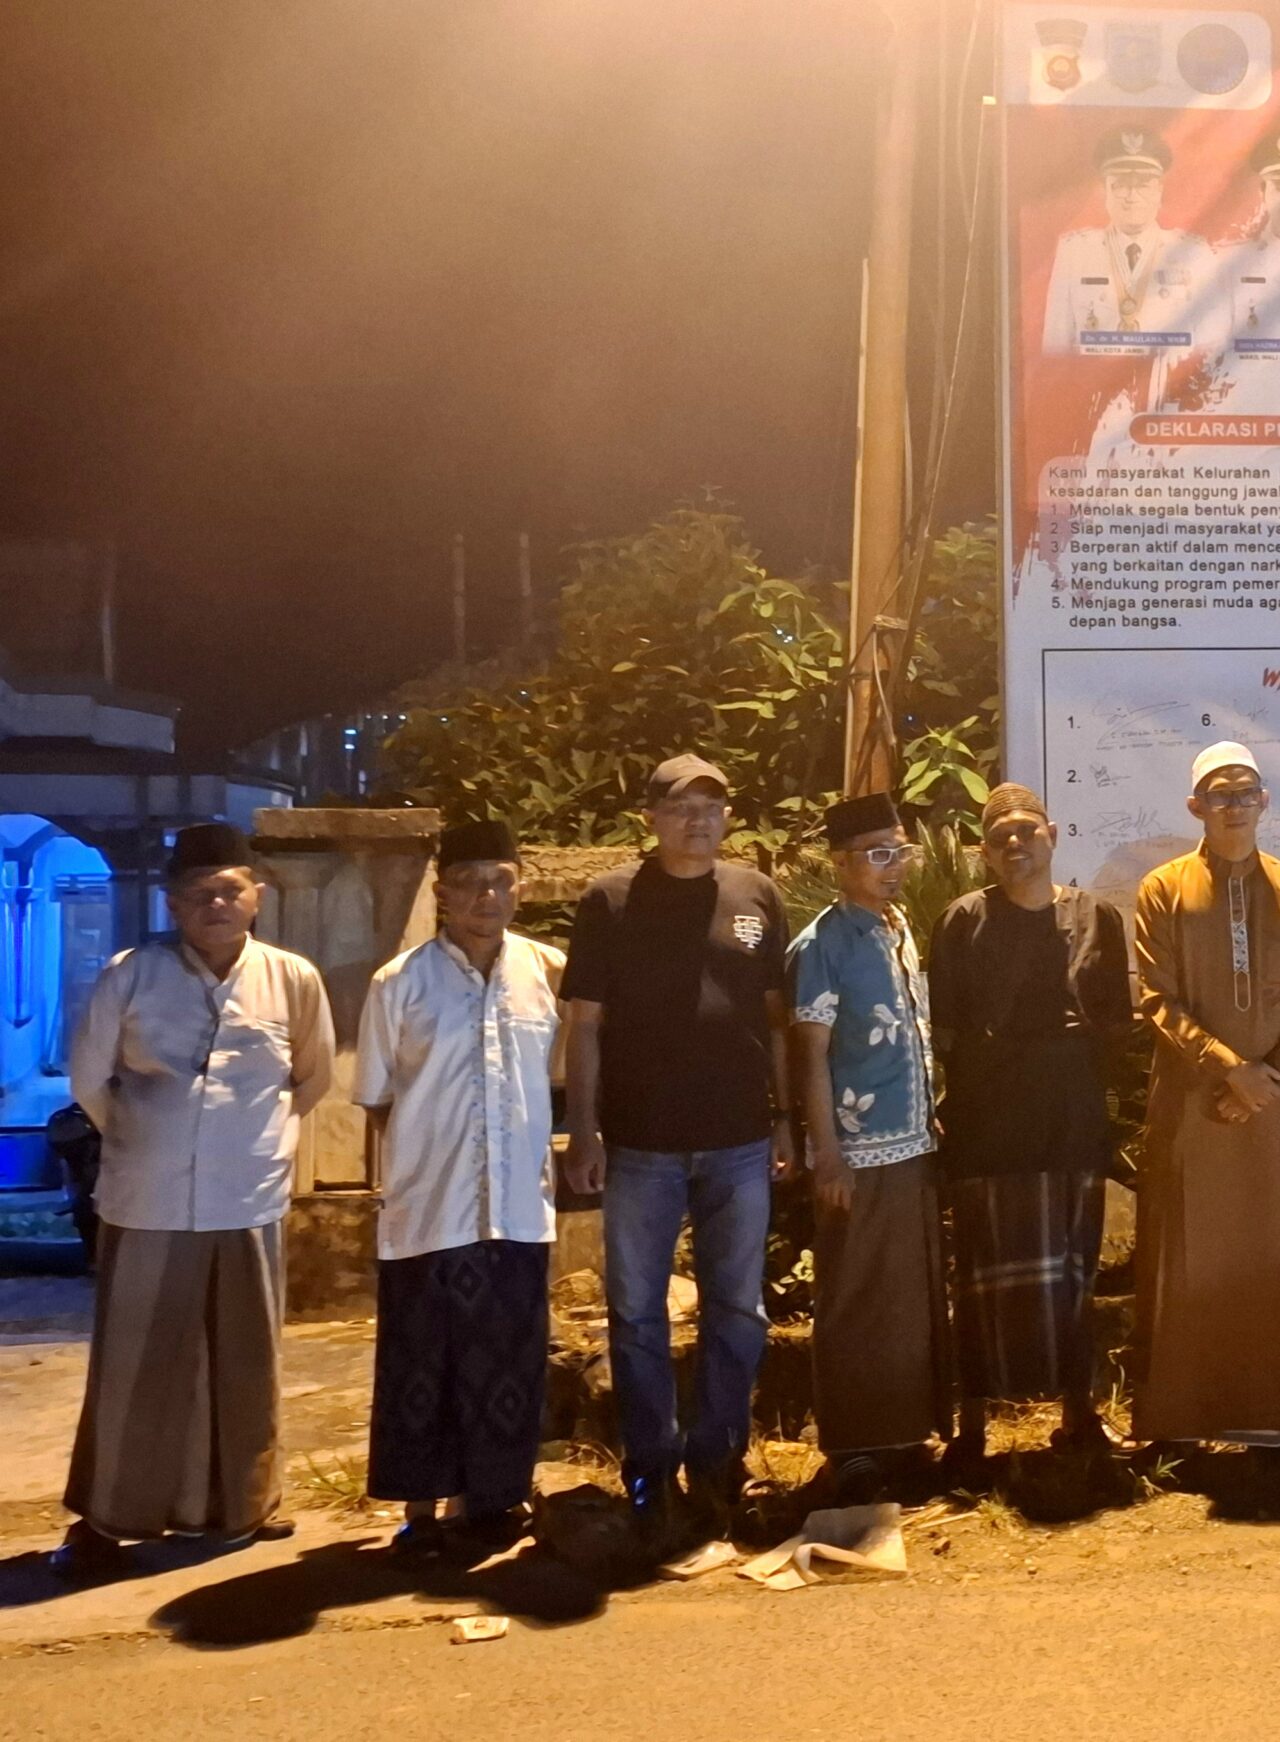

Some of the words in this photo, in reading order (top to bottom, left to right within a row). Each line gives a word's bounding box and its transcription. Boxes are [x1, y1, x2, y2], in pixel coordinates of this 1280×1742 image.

[1146, 422, 1257, 437] DEKLARASI
[1049, 466, 1087, 478] Kami
[1096, 466, 1184, 482] masyarakat
[1194, 467, 1270, 479] Kelurahan
[1049, 485, 1129, 497] kesadaran
[1135, 485, 1162, 497] dan
[1168, 485, 1238, 501] tanggung
[1070, 504, 1133, 516] Menolak
[1139, 504, 1189, 519] segala
[1195, 504, 1245, 516] bentuk
[1070, 522, 1104, 536] Siap
[1110, 522, 1168, 537] menjadi
[1175, 522, 1262, 538] masyarakat
[1070, 540, 1140, 556] Berperan
[1146, 540, 1178, 553] aktif
[1183, 540, 1228, 553] dalam
[1071, 561, 1107, 574] yang
[1113, 559, 1183, 571] berkaitan
[1189, 559, 1245, 574] dengan
[1071, 578, 1159, 592] Mendukung
[1165, 580, 1227, 593] program
[1052, 596, 1065, 609] 5.
[1071, 596, 1136, 611] Menjaga
[1142, 595, 1207, 611] generasi
[1213, 596, 1253, 608] muda
[1069, 615, 1116, 630] depan
[1122, 615, 1182, 630] bangsa.
[1067, 716, 1081, 729] 1.
[1201, 713, 1216, 727] 6.
[1067, 770, 1082, 783] 2.
[1068, 823, 1083, 837] 3.
